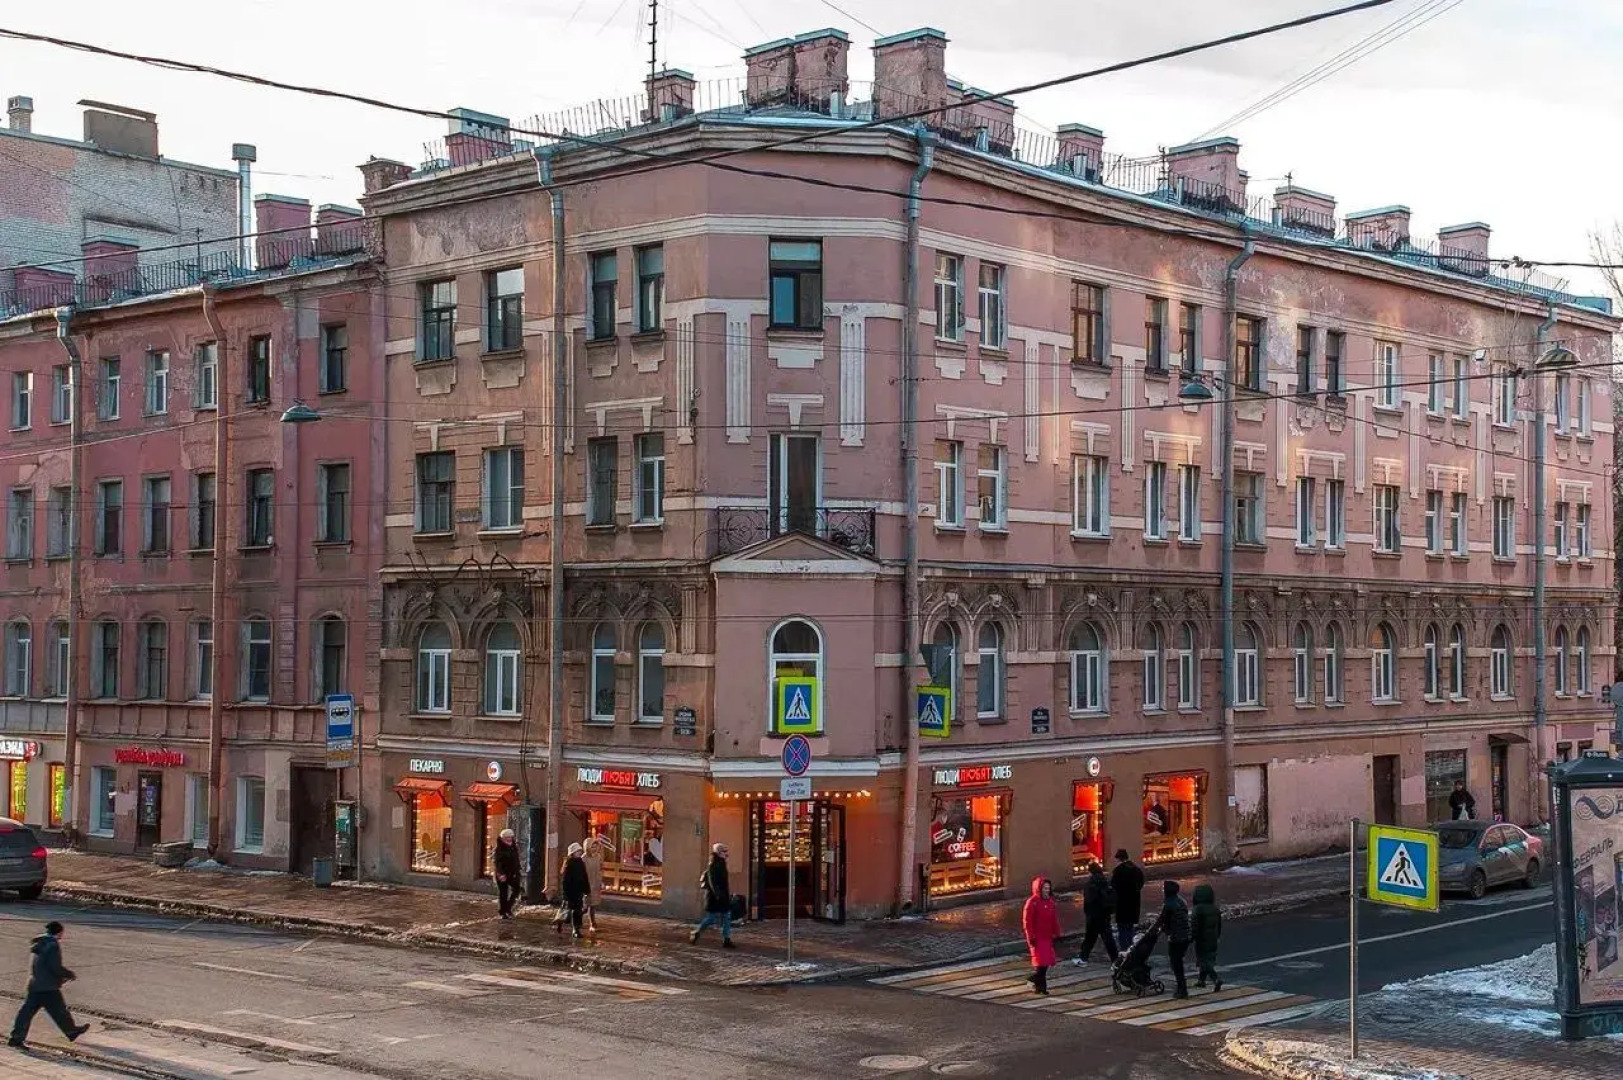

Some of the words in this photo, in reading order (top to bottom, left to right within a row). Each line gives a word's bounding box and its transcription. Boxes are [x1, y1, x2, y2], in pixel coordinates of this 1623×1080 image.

[410, 759, 444, 773] ПЕКАРНЯ
[935, 769, 960, 785] ЛЮДИ
[992, 765, 1012, 779] ХЛЕБ
[577, 767, 602, 785] ЛЮДИ
[636, 772, 659, 788] ХЛЕБ
[948, 841, 976, 853] COFFEE
[1573, 837, 1614, 869] ФЕВРАЛЬ
